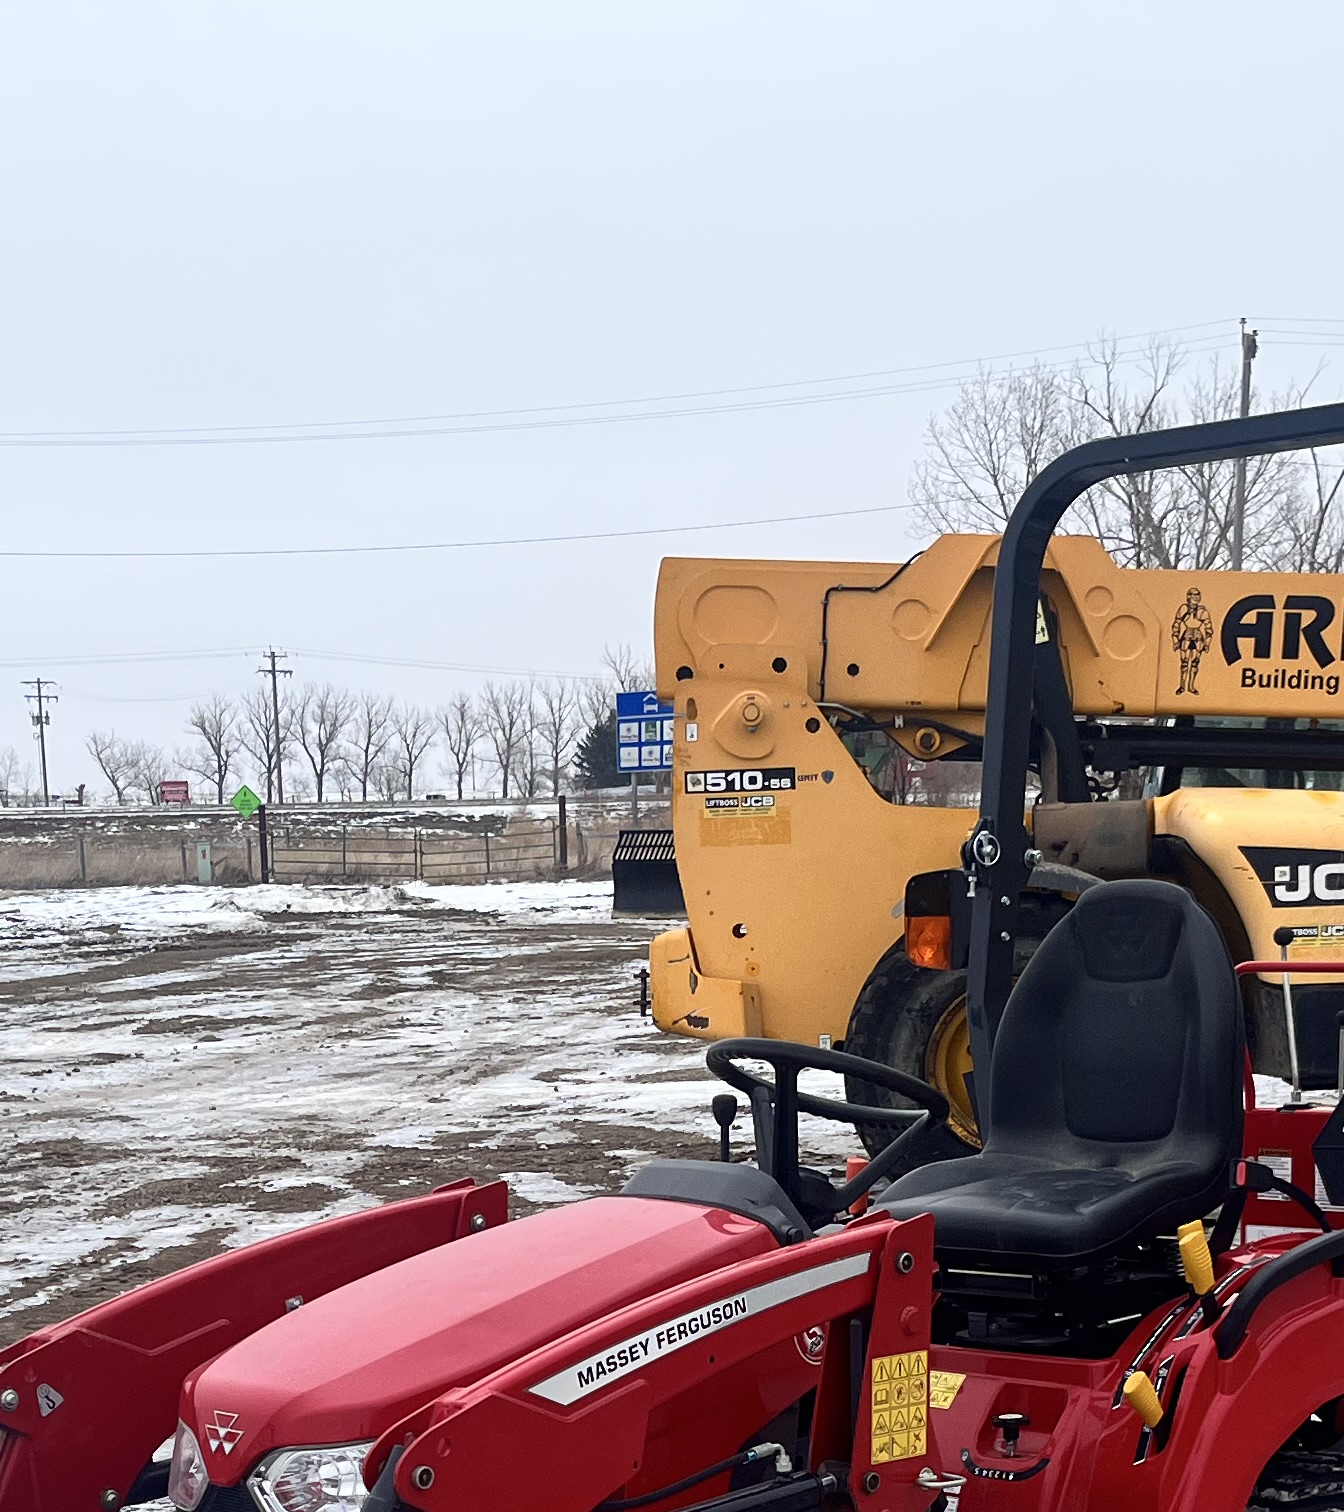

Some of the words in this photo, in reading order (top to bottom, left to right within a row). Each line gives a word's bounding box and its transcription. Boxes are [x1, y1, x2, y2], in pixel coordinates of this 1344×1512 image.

[1241, 668, 1340, 695] Building
[741, 796, 774, 807] JCB
[1293, 928, 1318, 936] TBOSS
[576, 1337, 650, 1388] MASSEY
[656, 1297, 747, 1349] FERGUSON
